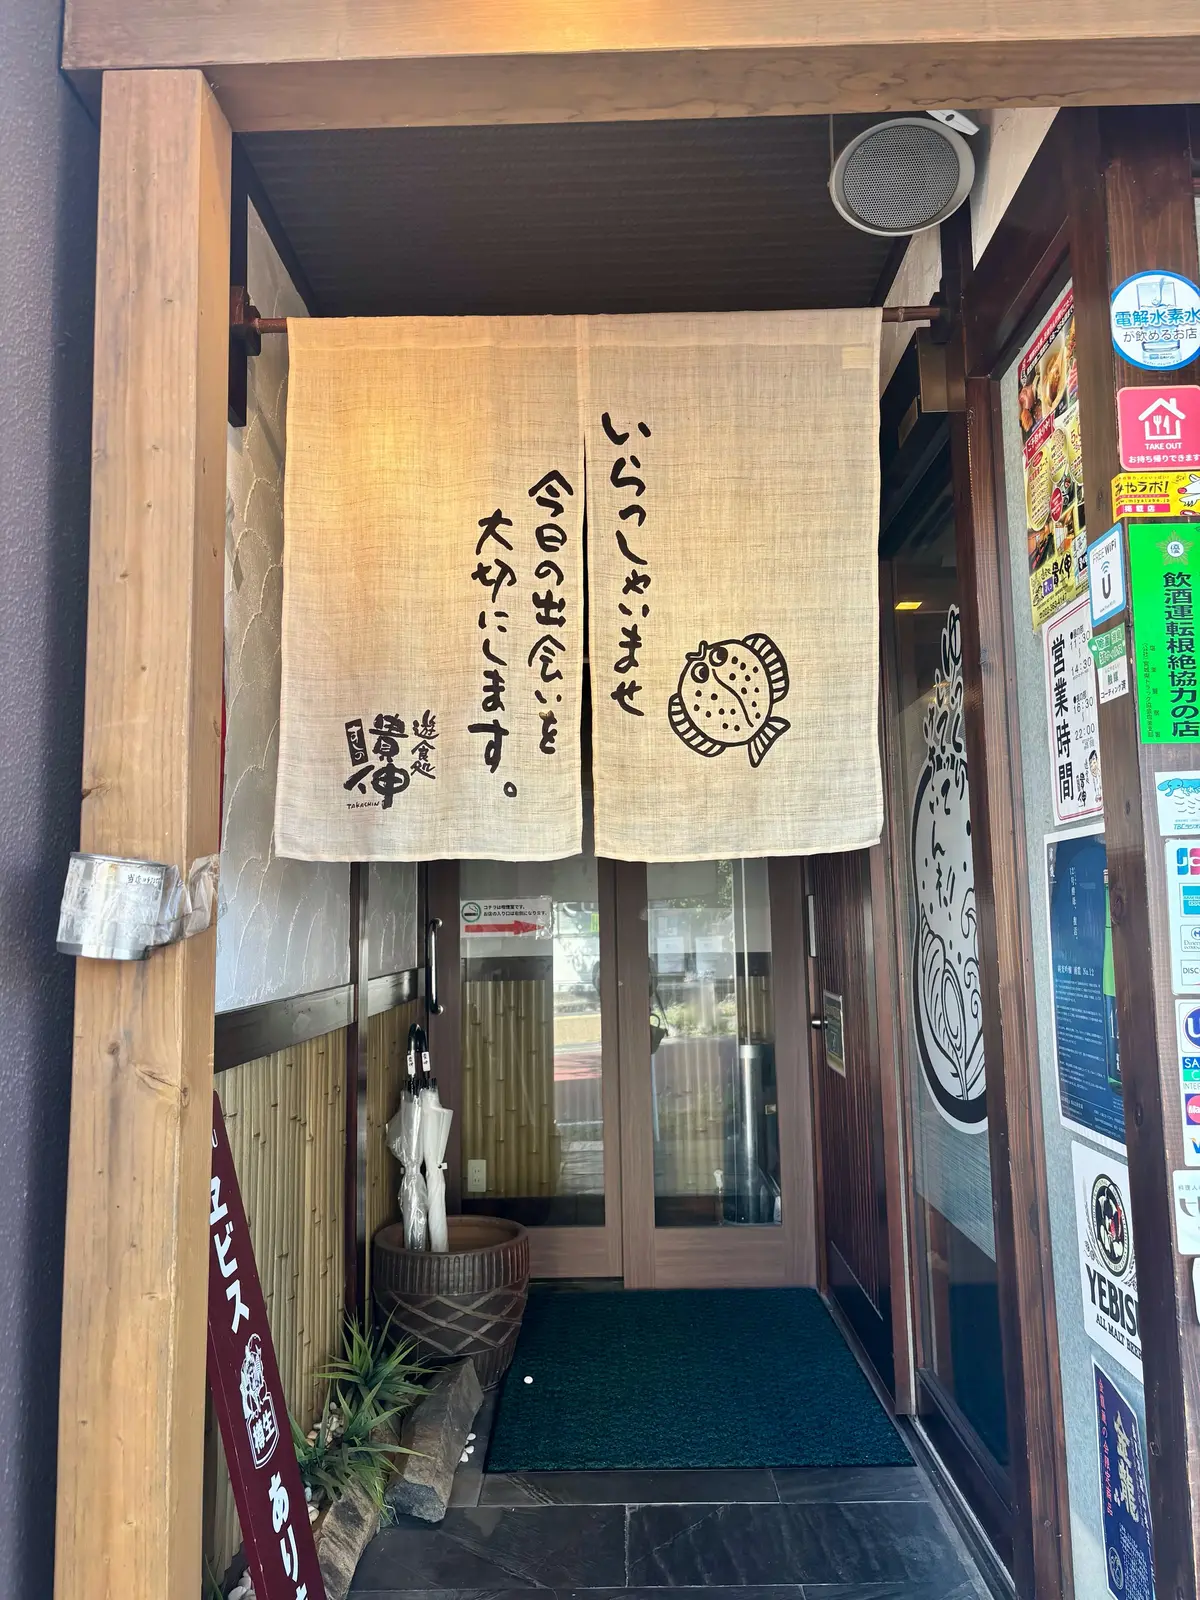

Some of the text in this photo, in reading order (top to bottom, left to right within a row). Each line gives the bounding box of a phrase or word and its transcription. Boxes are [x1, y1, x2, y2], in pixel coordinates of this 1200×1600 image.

[1115, 307, 1200, 326] 電解水素水
[1123, 328, 1198, 342] が飲めるお店
[1128, 454, 1200, 463] お持ち帰りできます
[1092, 538, 1117, 564] FREE WiFi
[601, 412, 651, 716] いらっしゃいませ
[528, 469, 574, 754] 今日の出会いを
[1069, 630, 1091, 650] 11:30
[467, 508, 518, 798] 大切にします。
[1163, 572, 1200, 737] 飲酒運転根絶協力の店
[1071, 656, 1092, 676] 14:30
[1101, 679, 1126, 699] コーティング済
[1073, 697, 1094, 714] 16:30
[1051, 633, 1074, 803] 営業時間
[1075, 723, 1095, 741] 22:00
[410, 709, 439, 779] 遊食処
[343, 713, 410, 809] 貴伸
[347, 801, 379, 810] TAKASHIN
[1096, 1313, 1107, 1333] ALL
[1108, 1321, 1125, 1347] MALT
